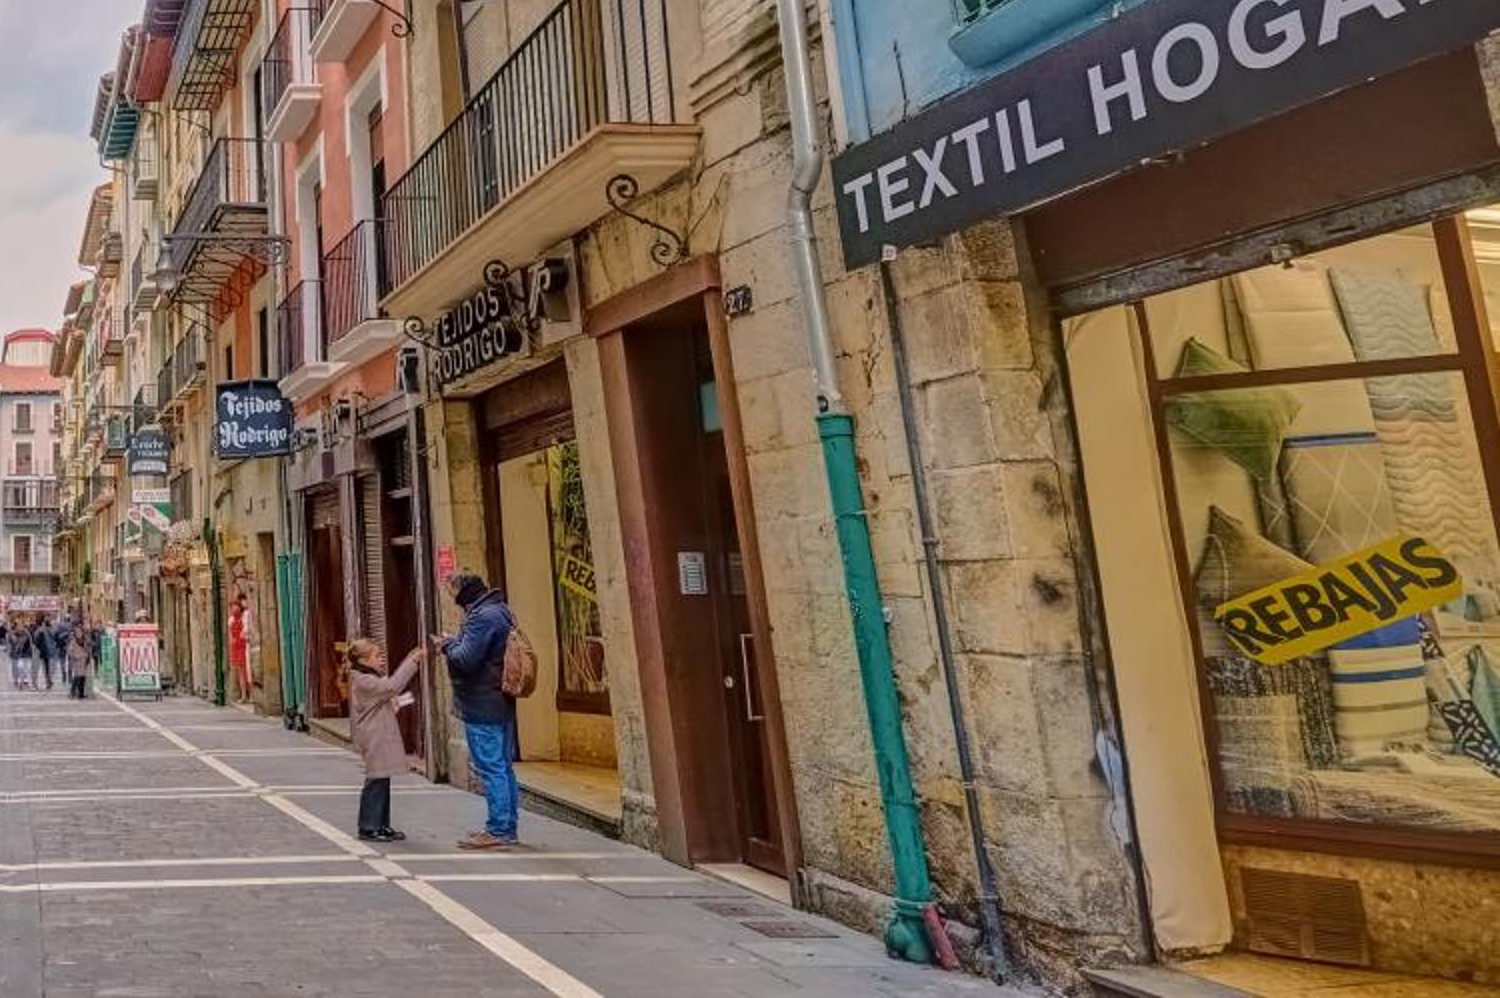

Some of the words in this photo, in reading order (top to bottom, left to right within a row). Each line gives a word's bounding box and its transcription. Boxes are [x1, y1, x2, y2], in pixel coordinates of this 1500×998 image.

[843, 98, 1065, 233] TEXTIL
[433, 288, 499, 347] TEJIDOS
[432, 321, 506, 383] RODRIGO
[219, 391, 283, 419] Tejidos
[219, 421, 288, 449] Rodrigo
[1222, 537, 1457, 657] REBAJAS
